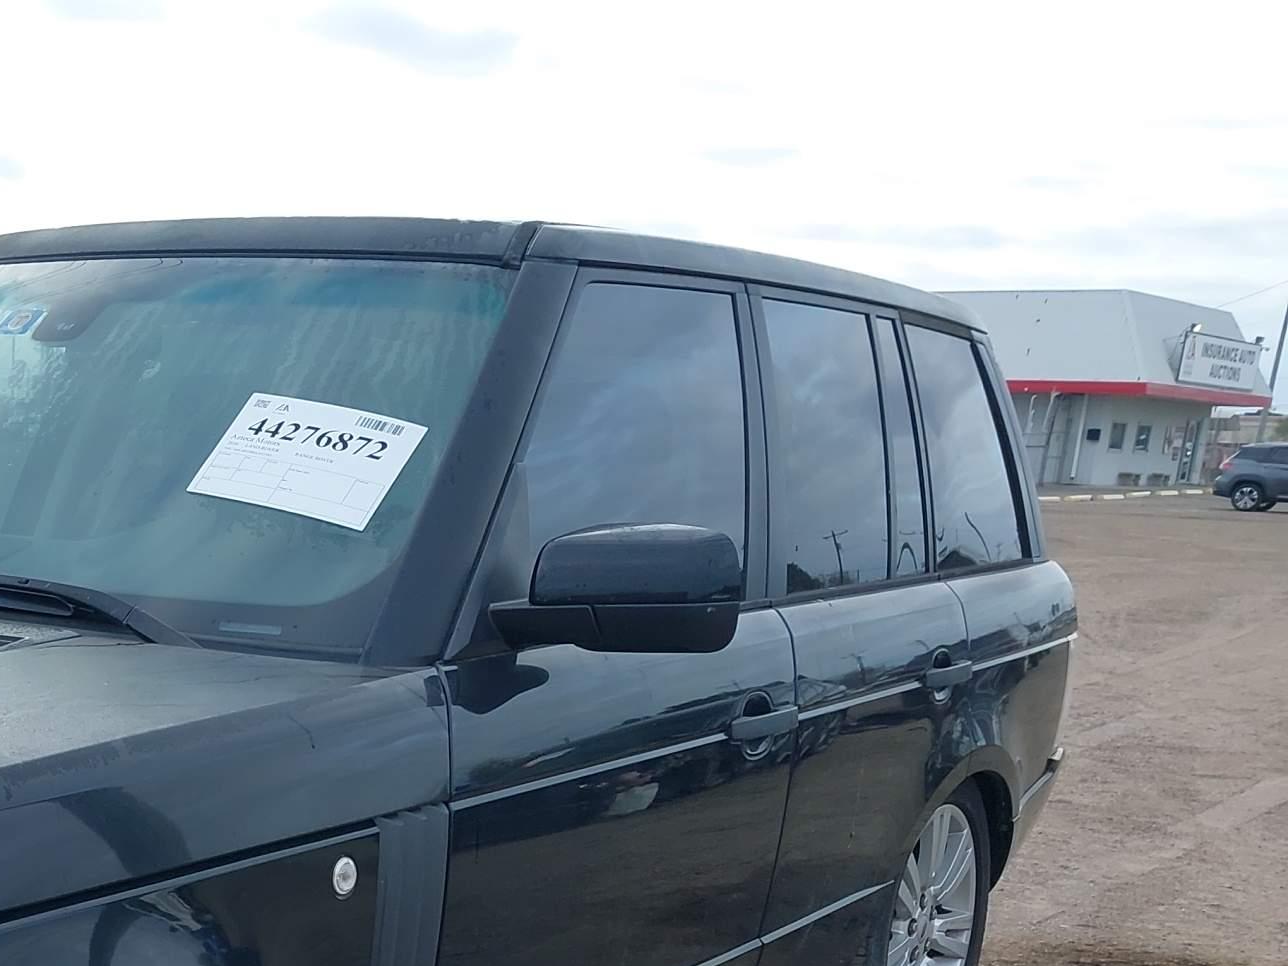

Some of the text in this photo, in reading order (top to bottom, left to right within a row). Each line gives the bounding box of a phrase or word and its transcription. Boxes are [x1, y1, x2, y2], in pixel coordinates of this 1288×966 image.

[1201, 342, 1239, 363] INSURANCE
[1238, 349, 1257, 366] AUTO
[1208, 363, 1241, 383] AUCTIONS
[248, 417, 389, 461] 44276872
